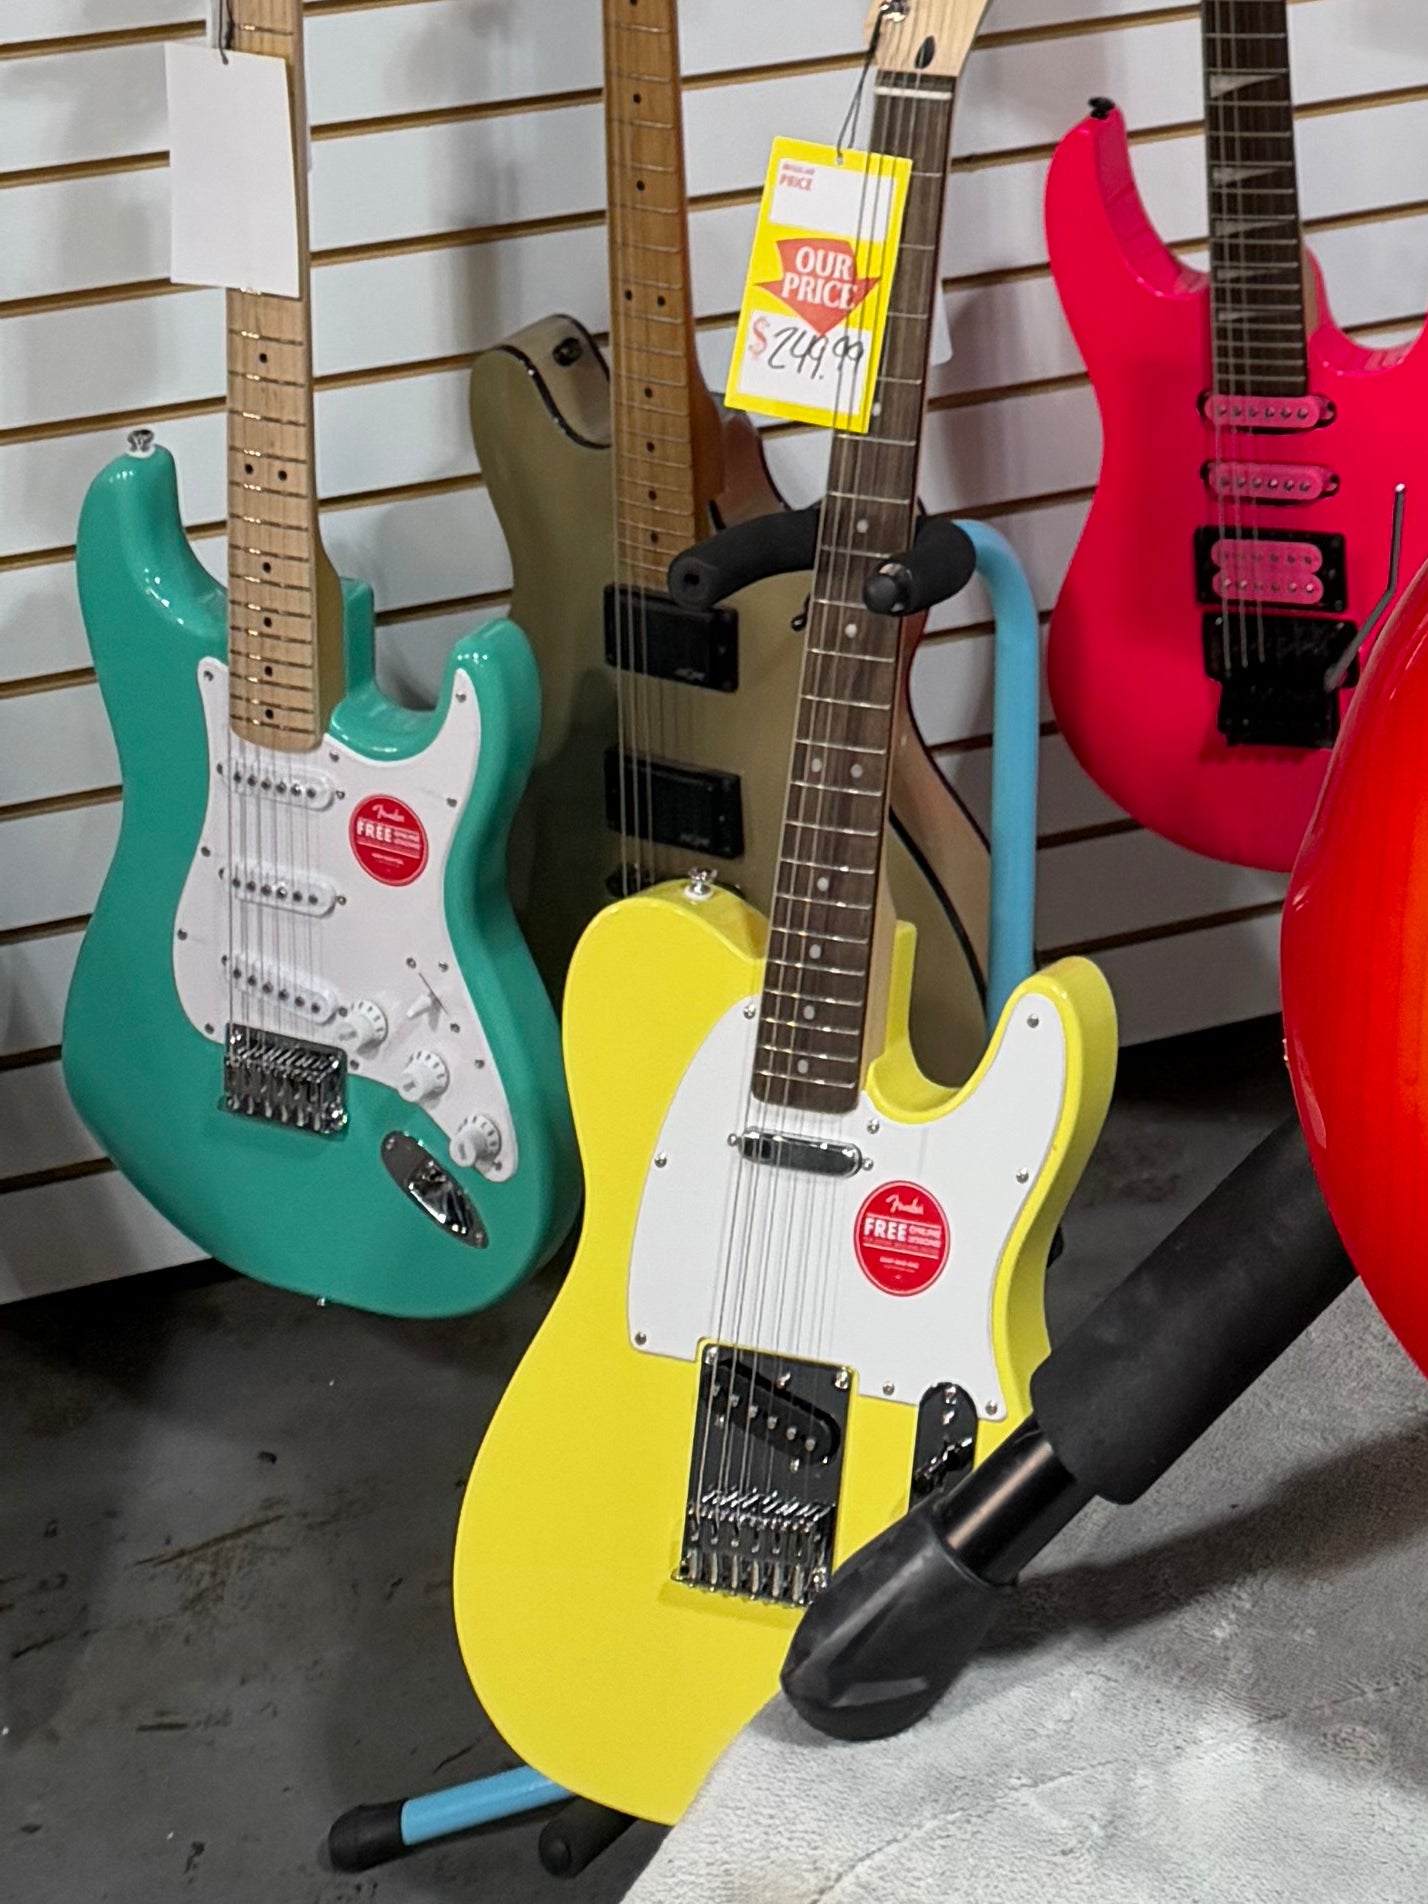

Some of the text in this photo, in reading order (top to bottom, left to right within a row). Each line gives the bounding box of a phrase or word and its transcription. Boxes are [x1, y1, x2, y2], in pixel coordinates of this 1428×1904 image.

[779, 175, 813, 192] PRICE
[795, 247, 853, 280] OUR
[781, 273, 857, 310] PRICE
[357, 820, 392, 842] FREE
[864, 1218, 908, 1242] FREE
